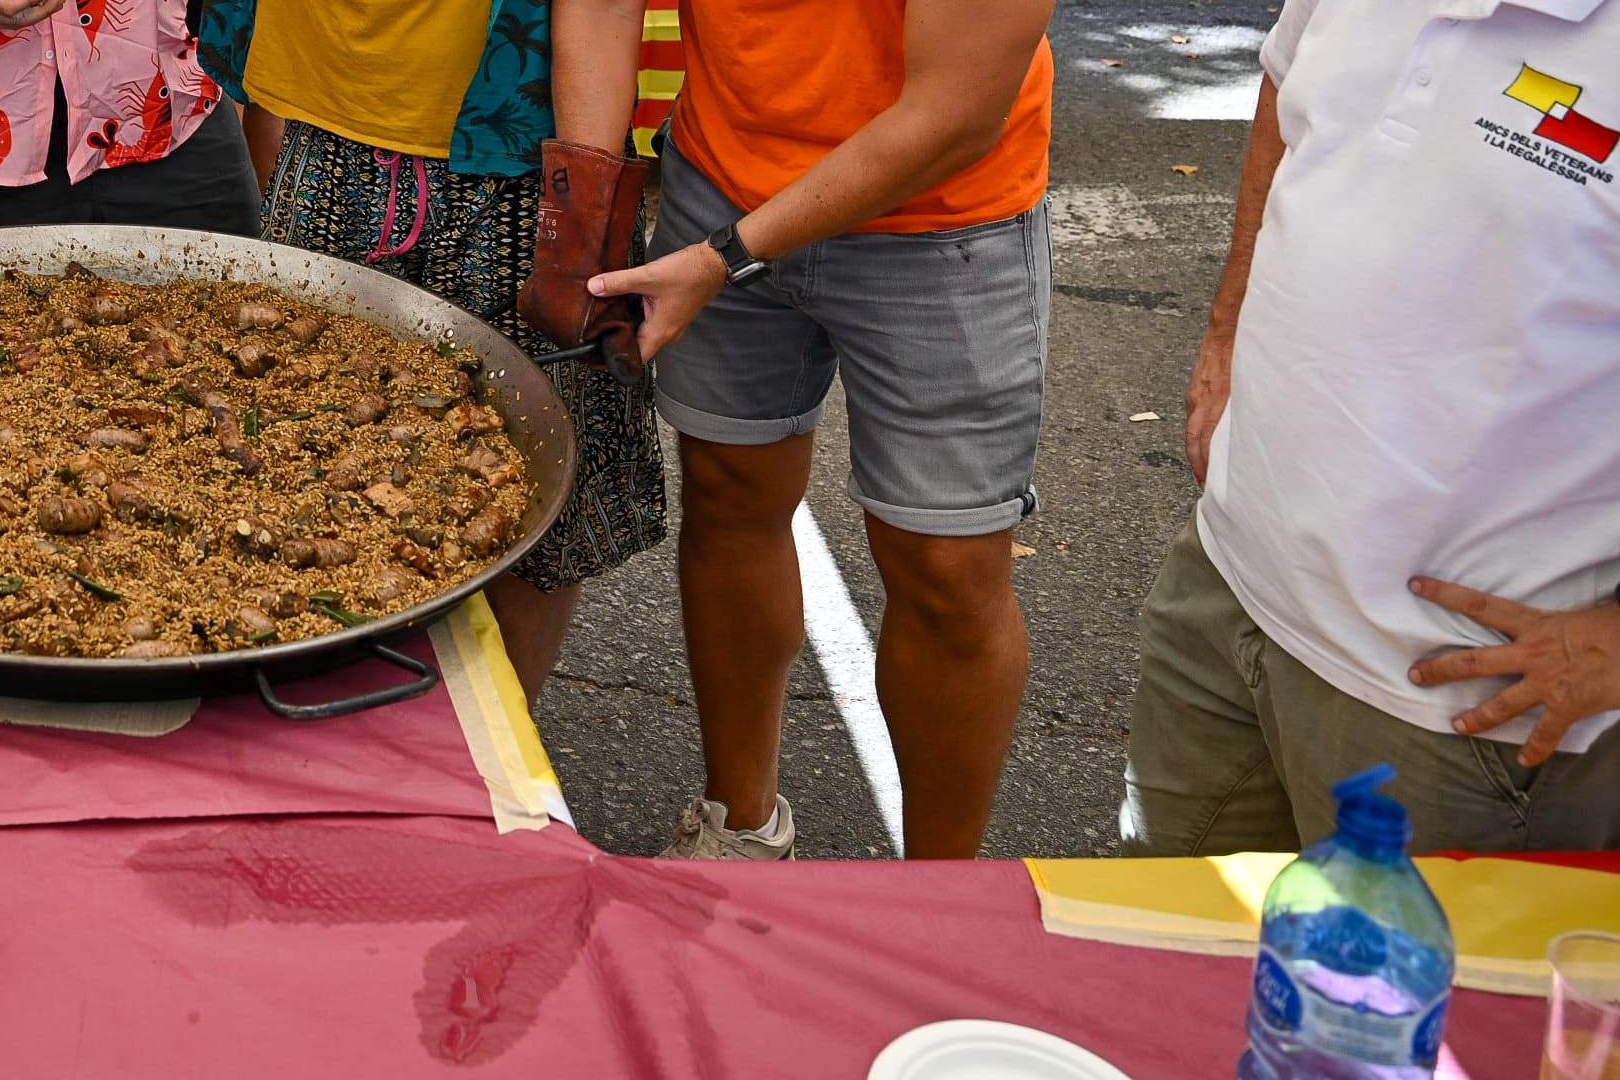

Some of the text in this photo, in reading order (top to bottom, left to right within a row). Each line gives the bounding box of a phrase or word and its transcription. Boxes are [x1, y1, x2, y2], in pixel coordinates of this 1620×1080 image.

[1474, 117, 1614, 183] AMICS DELS VETERANS
[1484, 134, 1490, 142] I
[1490, 137, 1505, 150] LA
